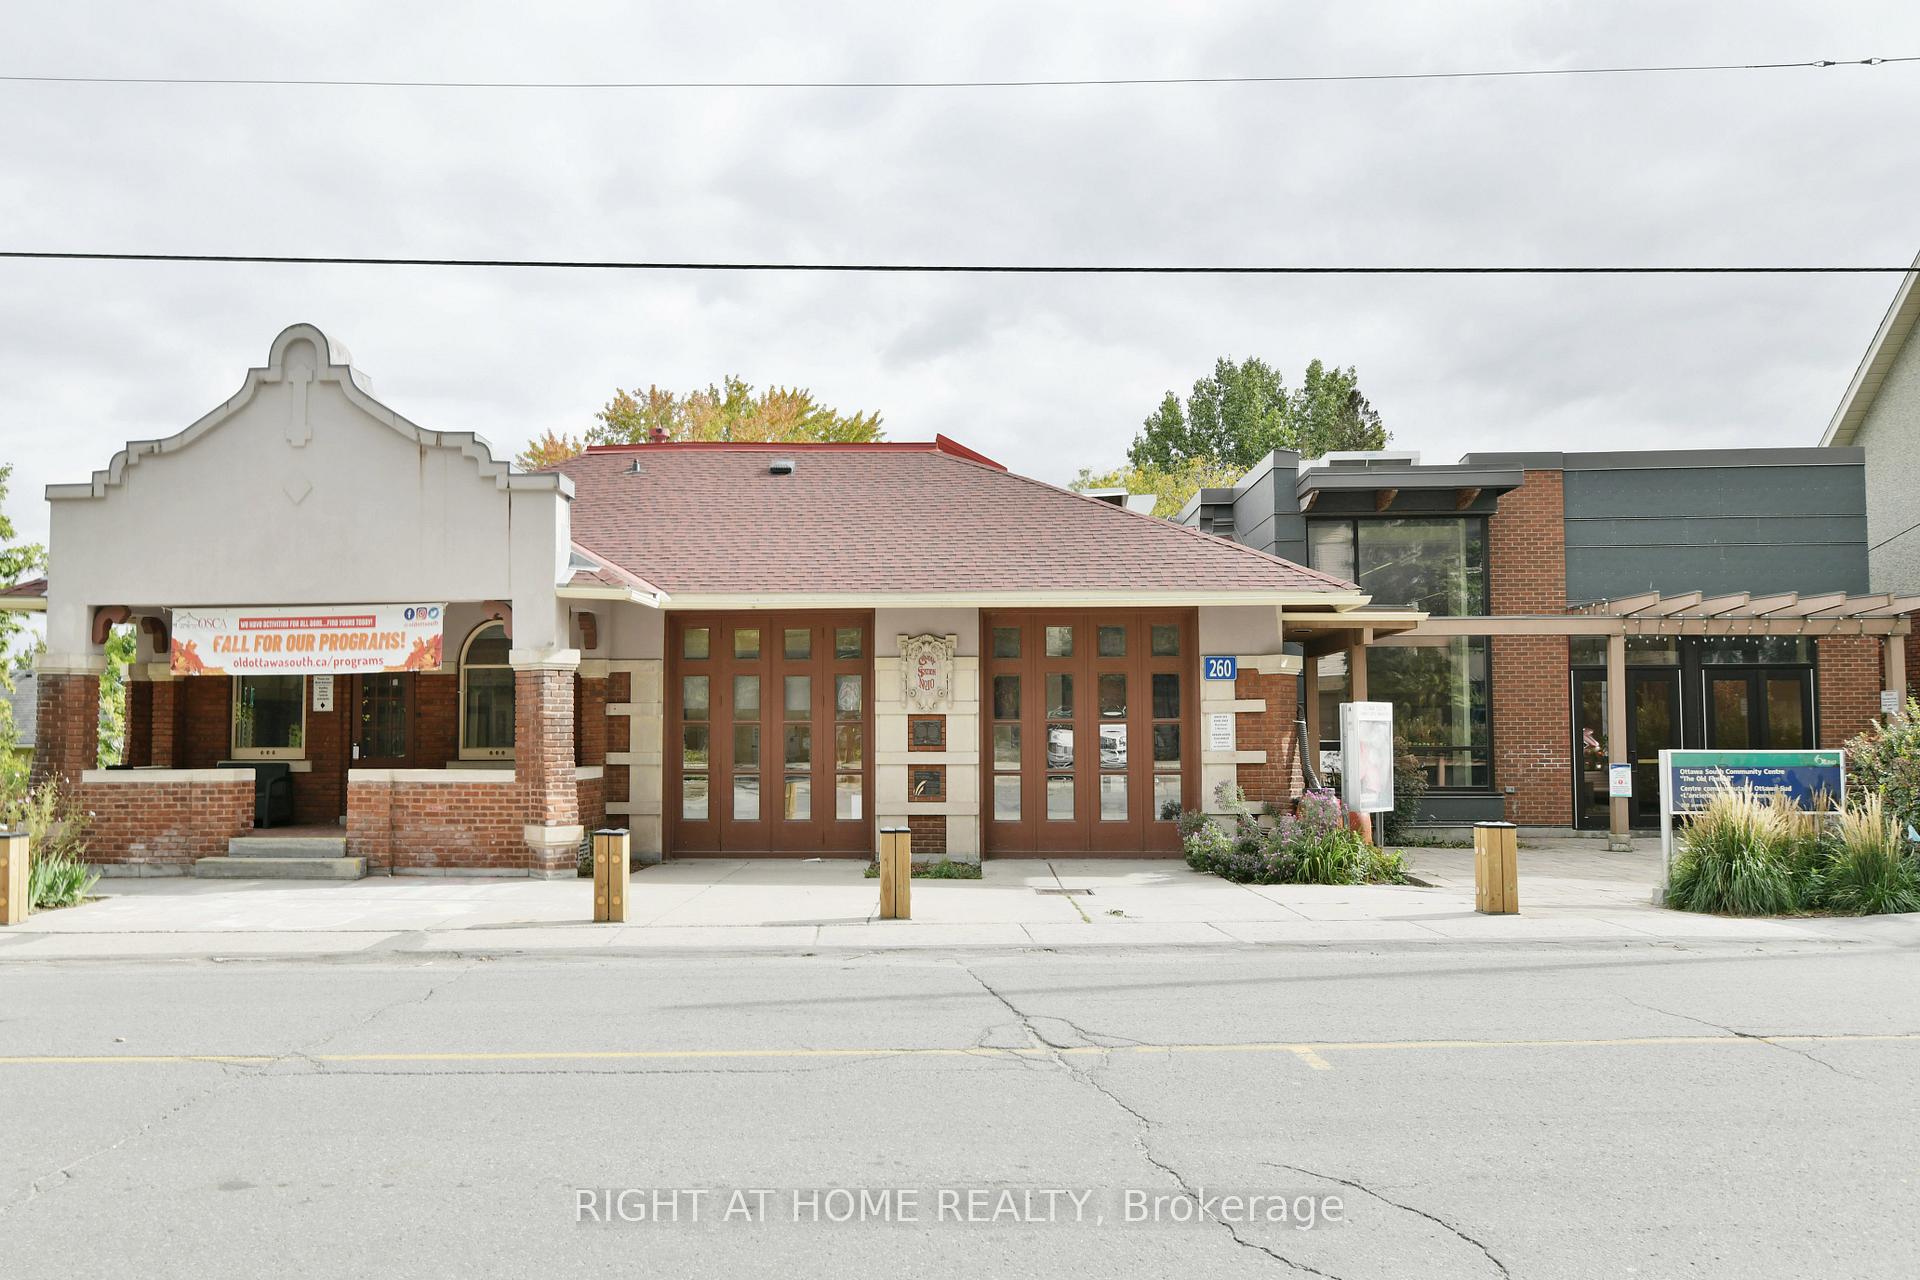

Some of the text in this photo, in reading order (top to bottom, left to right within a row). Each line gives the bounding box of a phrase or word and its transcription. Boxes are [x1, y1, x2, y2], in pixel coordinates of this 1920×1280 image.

[198, 618, 227, 629] OSCA
[213, 631, 406, 653] FALL FOR OUR PROGRAMS!
[233, 656, 384, 669] oldottawasouth.ca/programs
[1209, 659, 1232, 677] 260
[1725, 768, 1762, 776] Community
